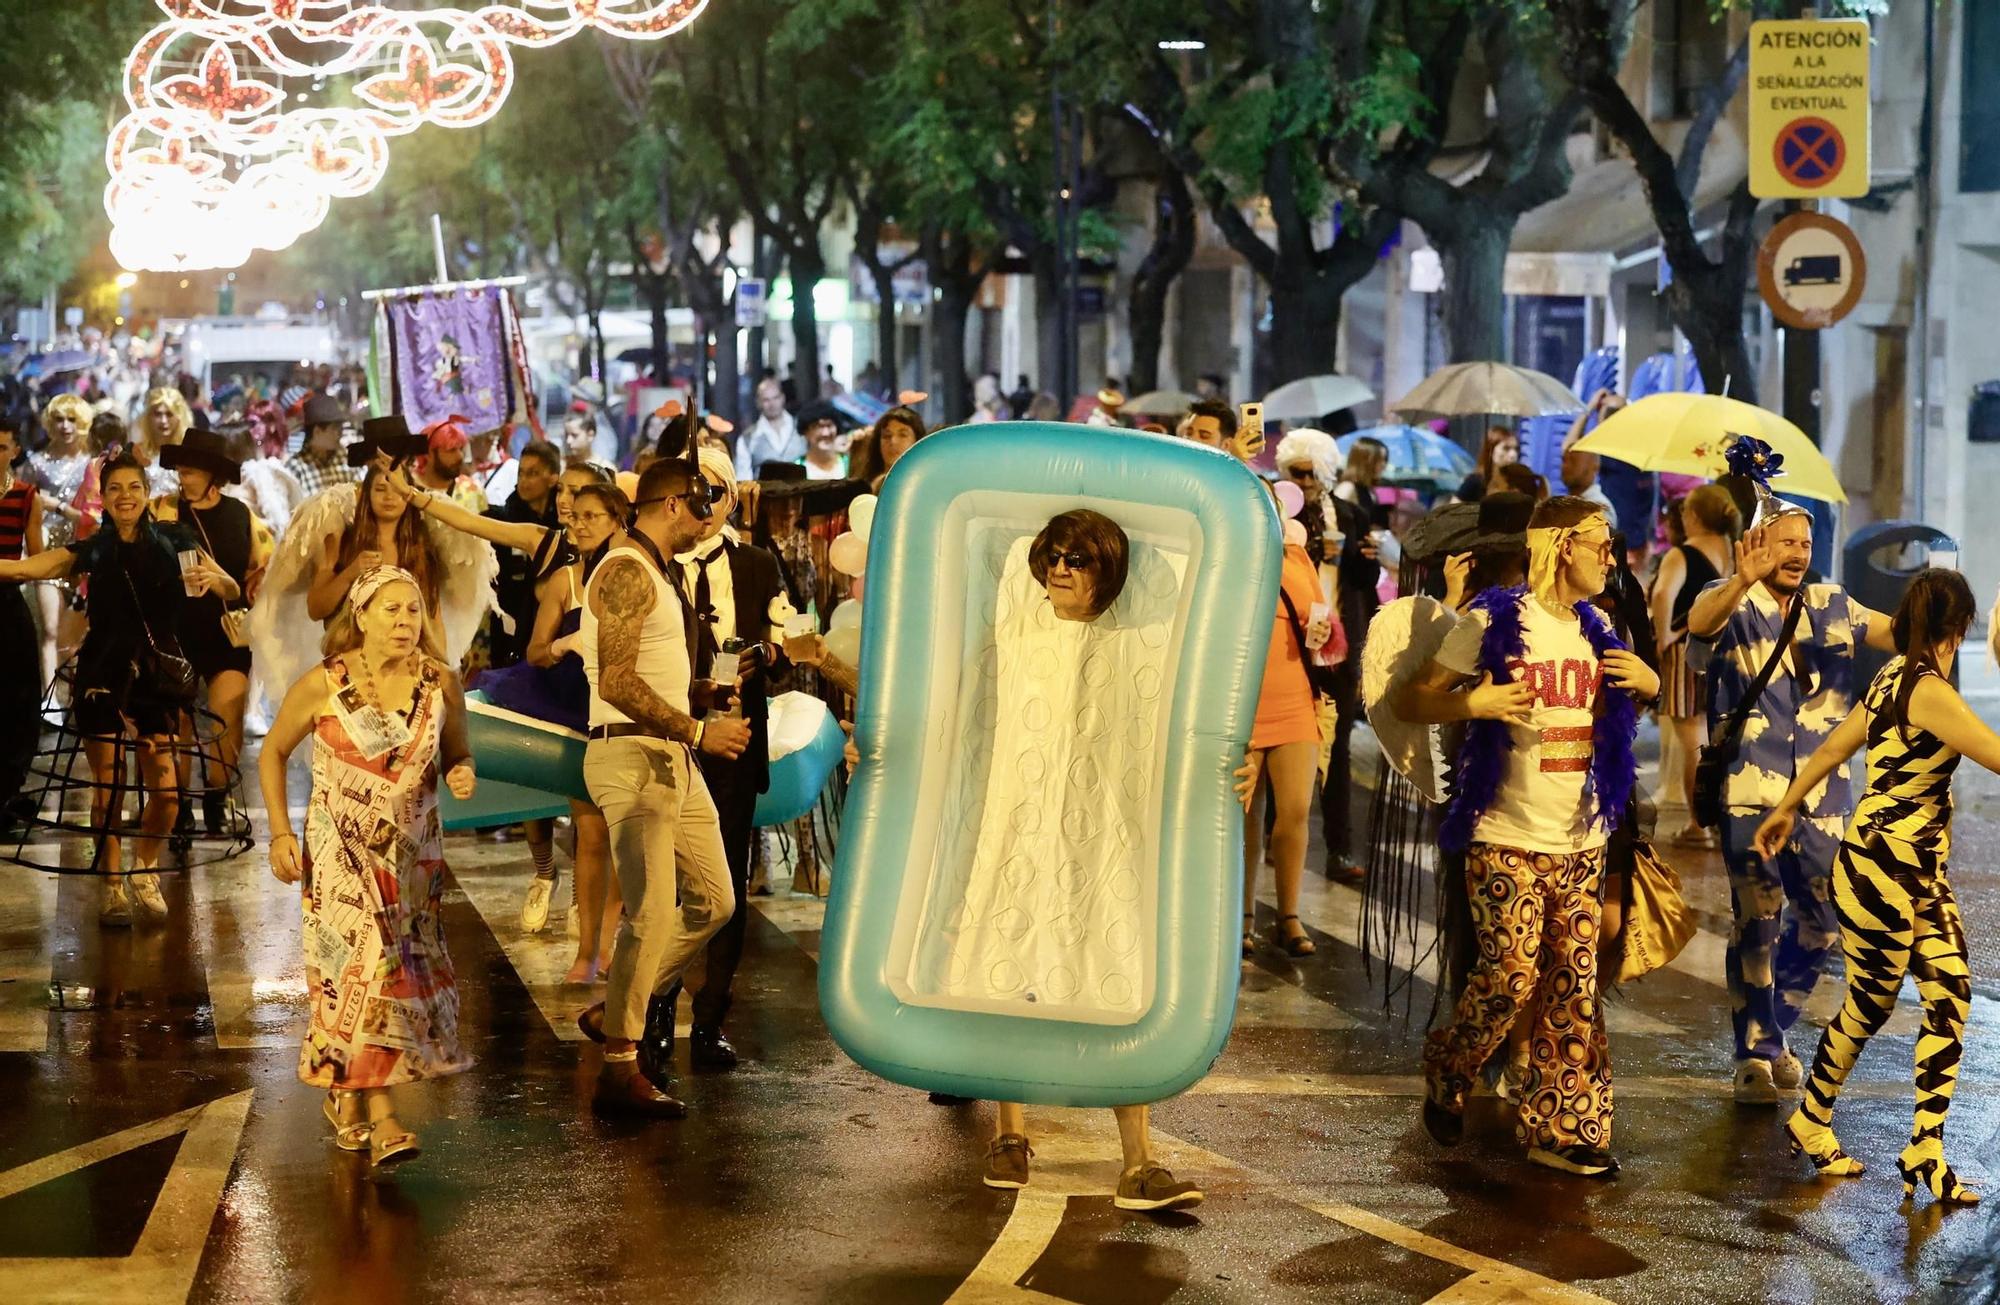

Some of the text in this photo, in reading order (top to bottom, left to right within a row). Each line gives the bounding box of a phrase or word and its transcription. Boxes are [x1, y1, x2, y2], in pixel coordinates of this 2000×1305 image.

[1759, 28, 1862, 48] ATENCIÓN
[1793, 56, 1827, 68] A LA
[1756, 75, 1864, 90] SEÑALIZACIÓN
[1770, 97, 1848, 110] EVENTUAL
[343, 989, 361, 1027] 52/23
